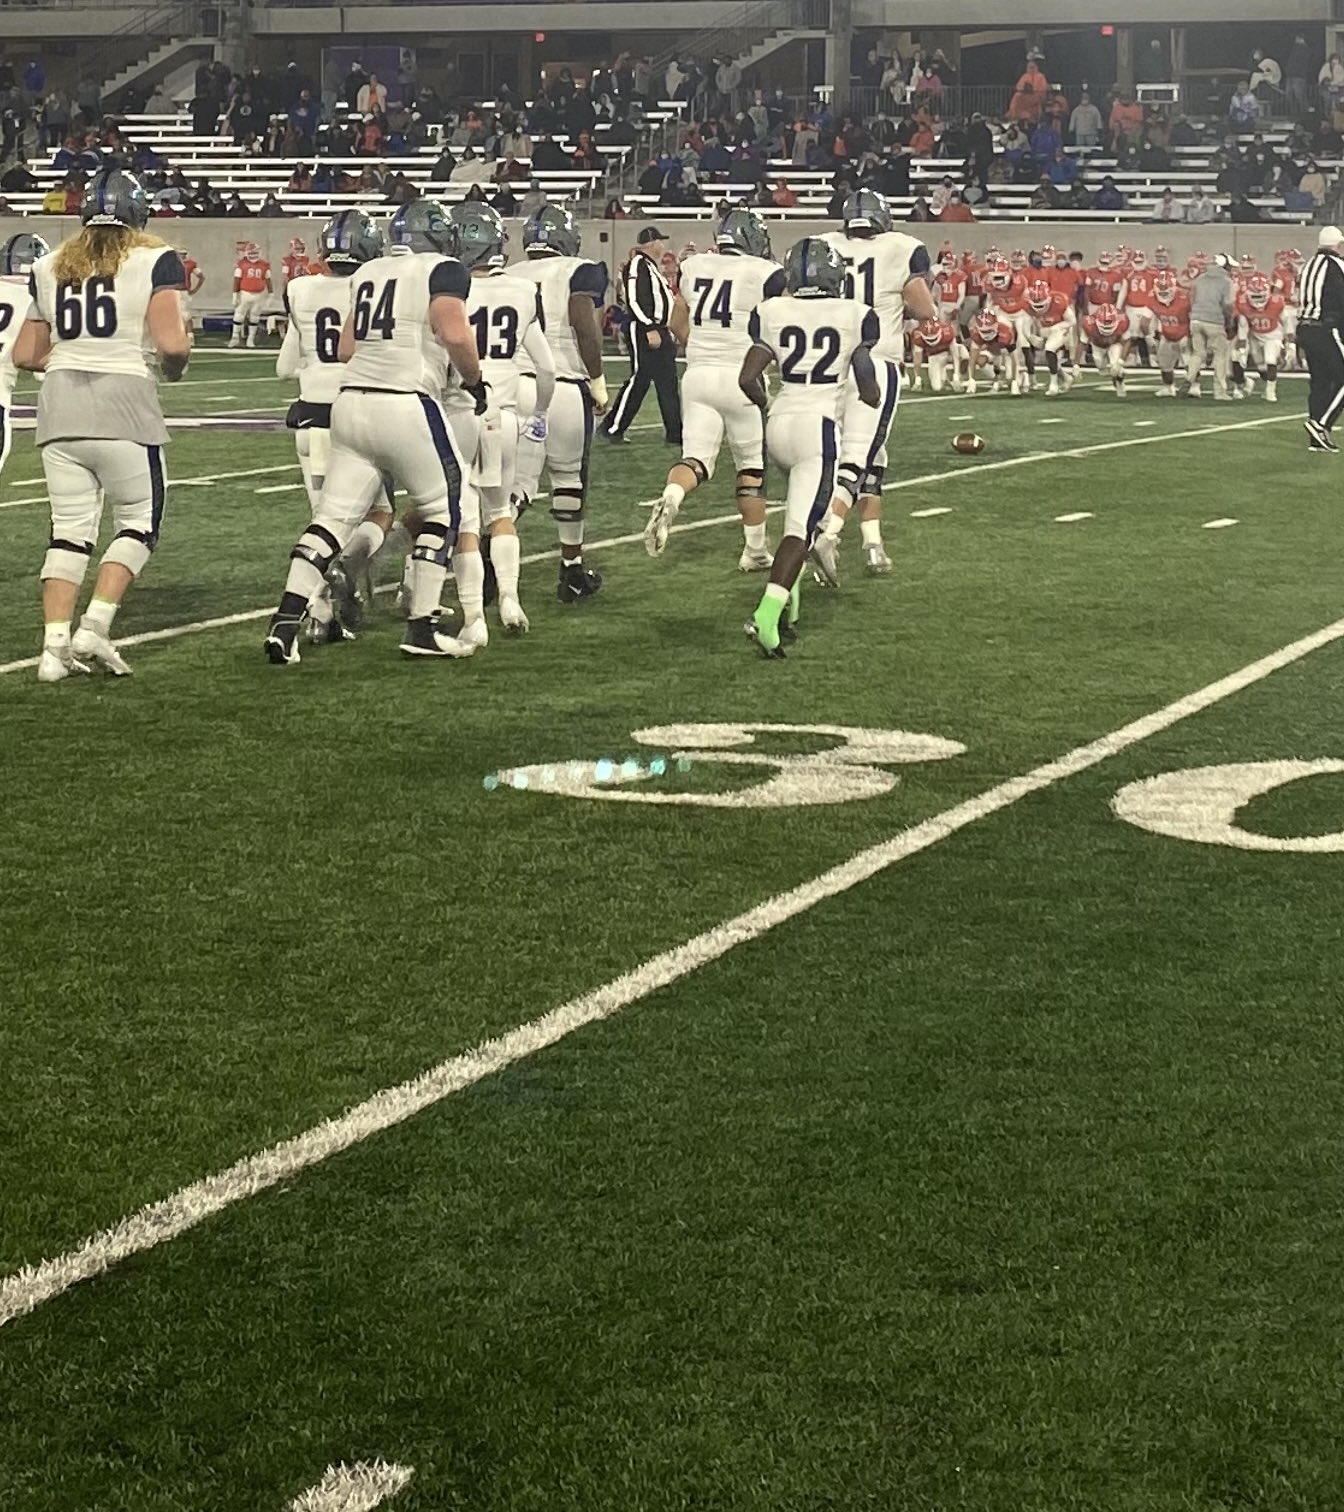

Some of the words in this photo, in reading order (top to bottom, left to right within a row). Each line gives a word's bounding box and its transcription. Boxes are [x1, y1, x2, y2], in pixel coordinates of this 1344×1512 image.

[56, 275, 118, 340] 66
[354, 279, 397, 341] 64
[693, 278, 733, 328] 74
[316, 307, 341, 363] 6
[469, 305, 519, 360] 13
[779, 325, 841, 385] 22
